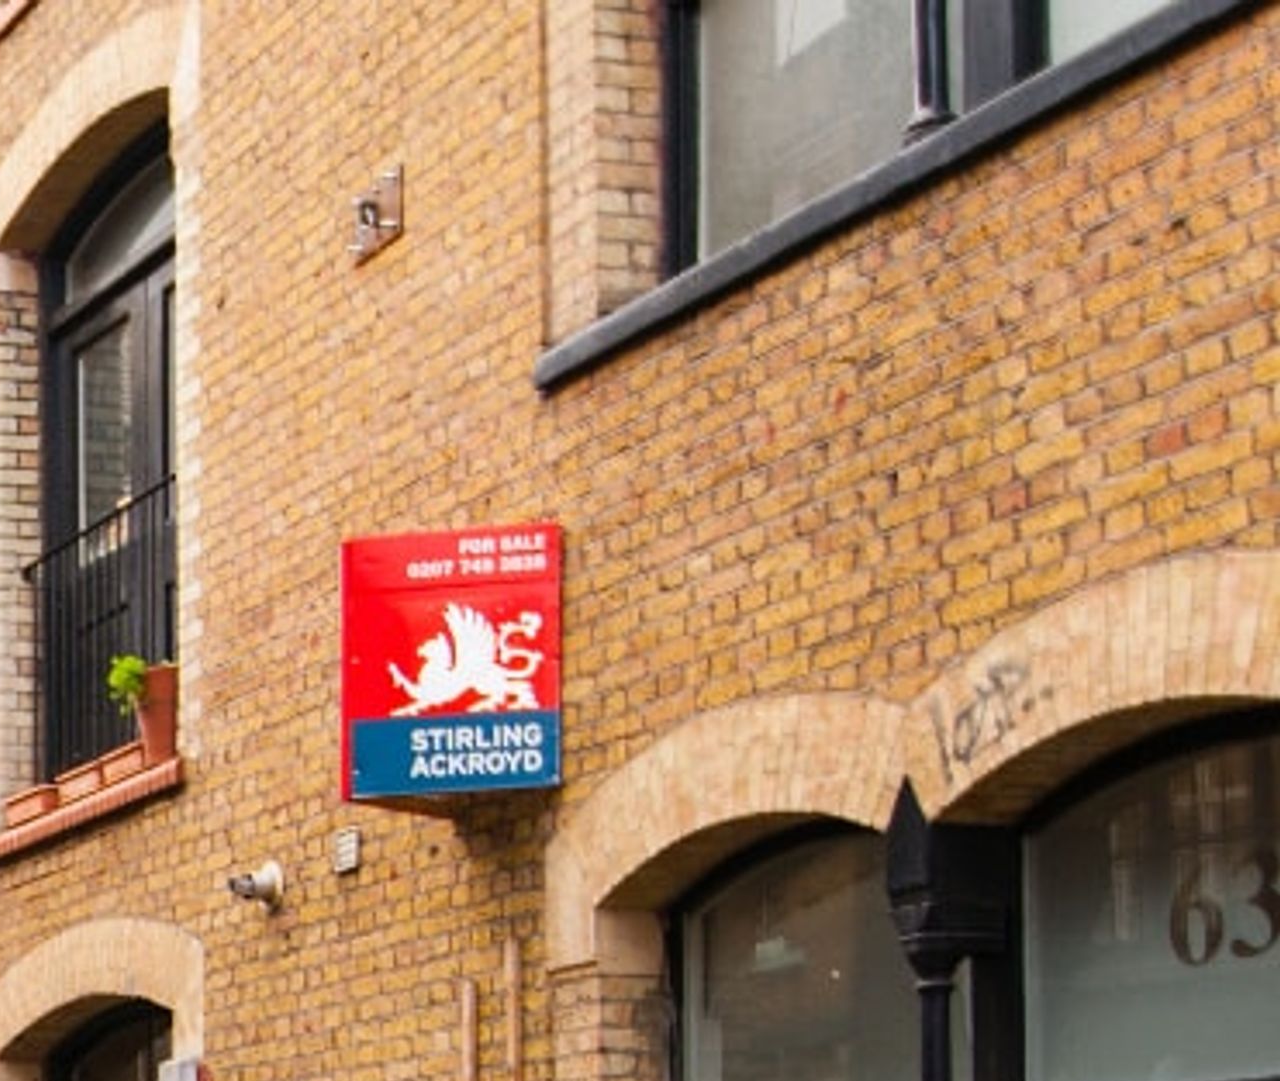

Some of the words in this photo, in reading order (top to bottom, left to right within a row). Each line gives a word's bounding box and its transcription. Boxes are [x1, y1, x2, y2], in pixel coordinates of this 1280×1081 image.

[410, 723, 542, 752] STIRLING
[410, 750, 542, 779] ACKROYD
[1169, 847, 1280, 967] 63
